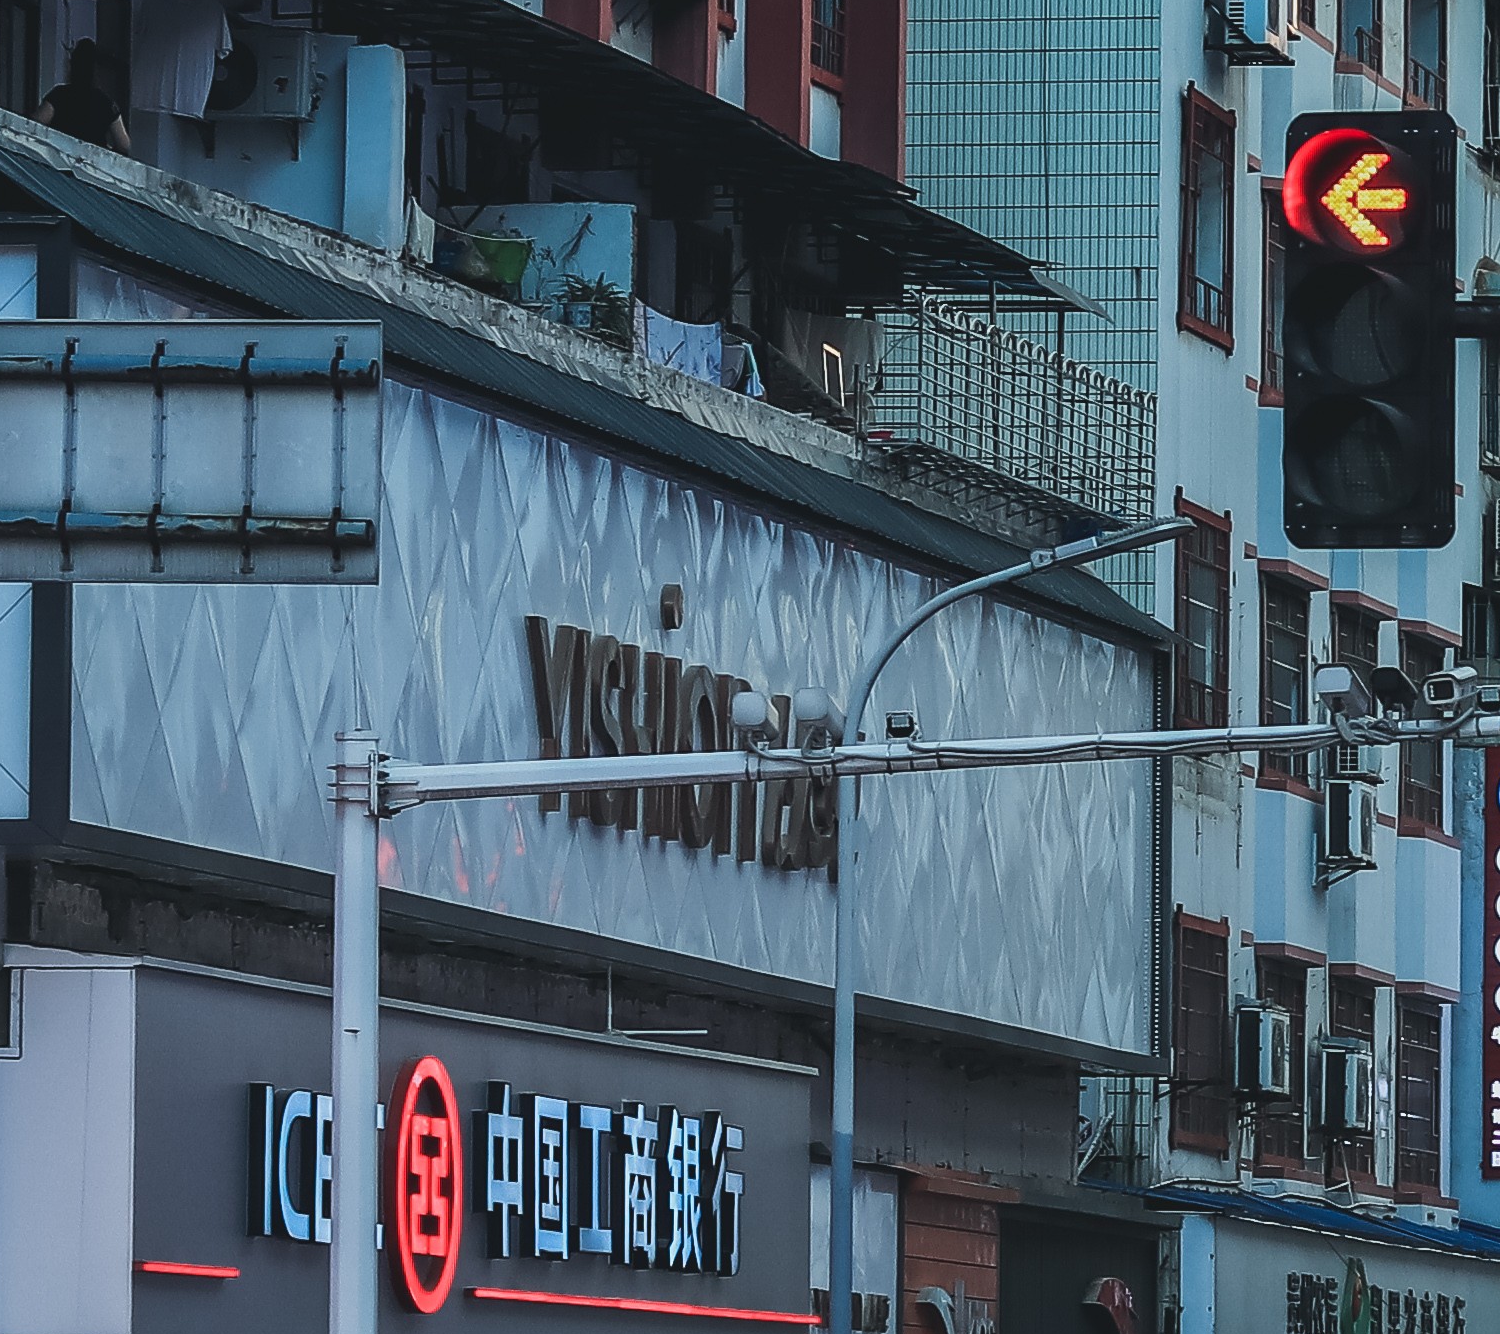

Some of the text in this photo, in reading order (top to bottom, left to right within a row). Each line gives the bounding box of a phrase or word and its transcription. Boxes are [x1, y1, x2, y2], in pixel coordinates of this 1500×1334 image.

[476, 1081, 744, 1276] 中国工商银行
